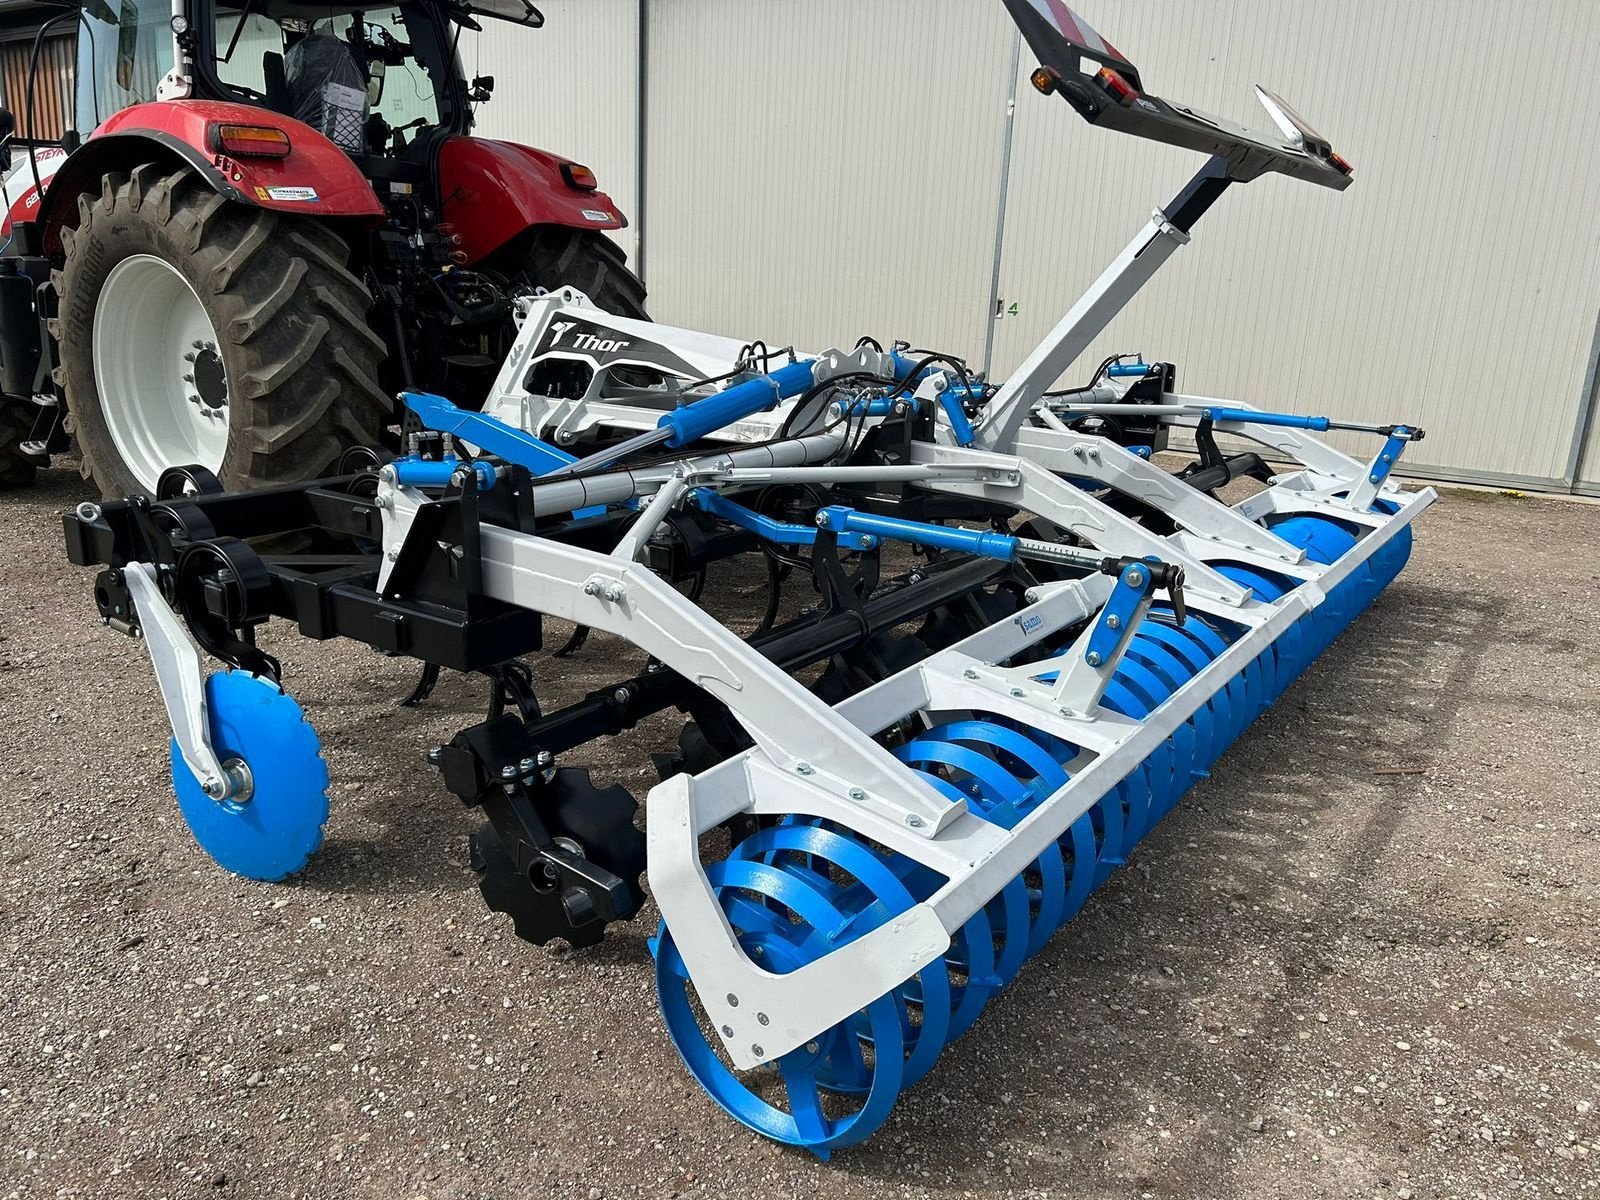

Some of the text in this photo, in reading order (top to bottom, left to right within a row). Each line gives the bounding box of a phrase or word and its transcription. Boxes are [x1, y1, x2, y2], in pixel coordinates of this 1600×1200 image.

[1007, 302, 1019, 317] 4
[572, 333, 630, 353] Thor
[1023, 615, 1042, 631] samo
